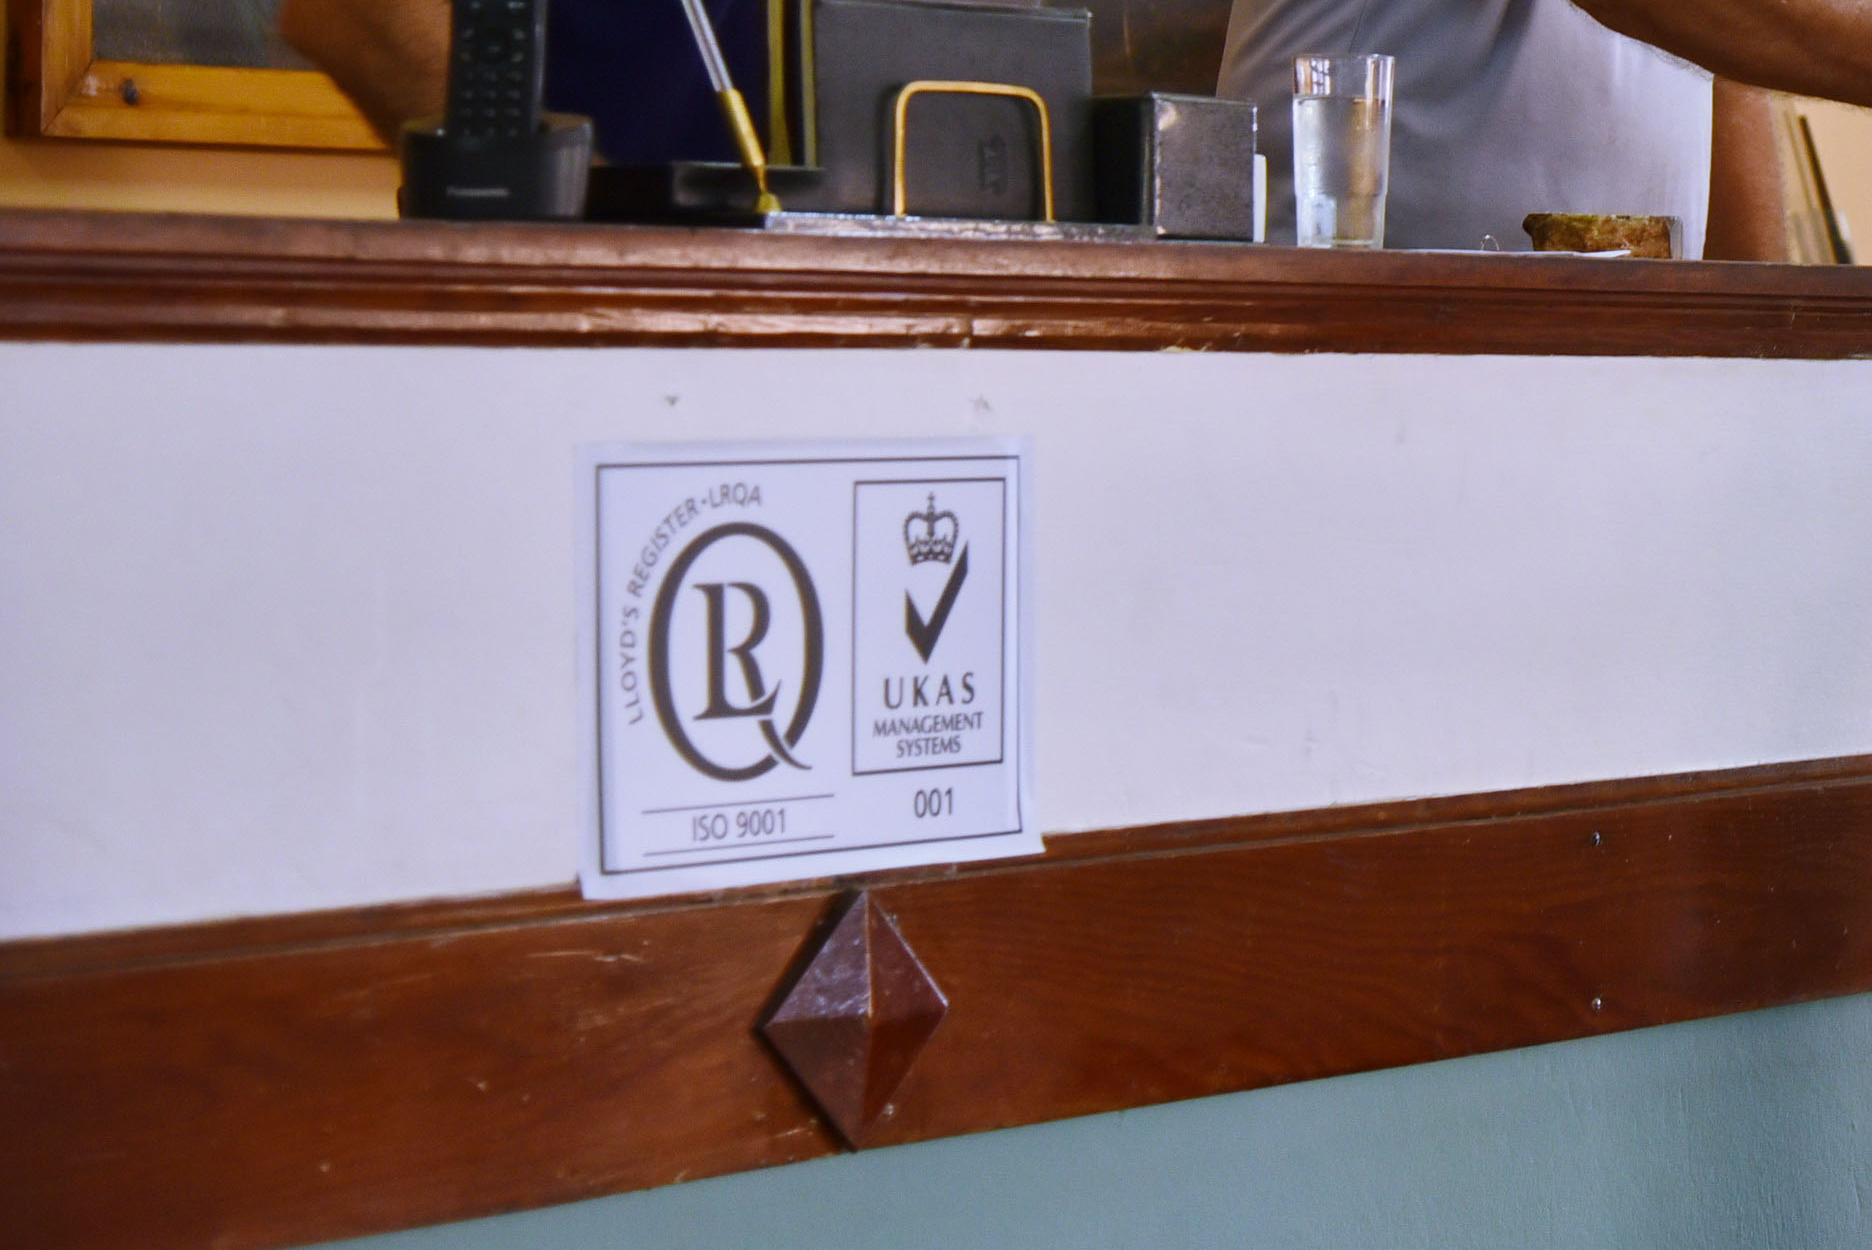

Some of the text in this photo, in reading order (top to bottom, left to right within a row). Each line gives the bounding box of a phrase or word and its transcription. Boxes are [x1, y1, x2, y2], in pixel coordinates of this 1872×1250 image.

[620, 605, 643, 725] LLOYD'S
[883, 671, 976, 710] UKAS
[872, 711, 984, 737] MANAGEMENT
[896, 734, 962, 759] SYSTEMS
[914, 786, 954, 819] 001
[692, 807, 786, 842] ISO 9001
